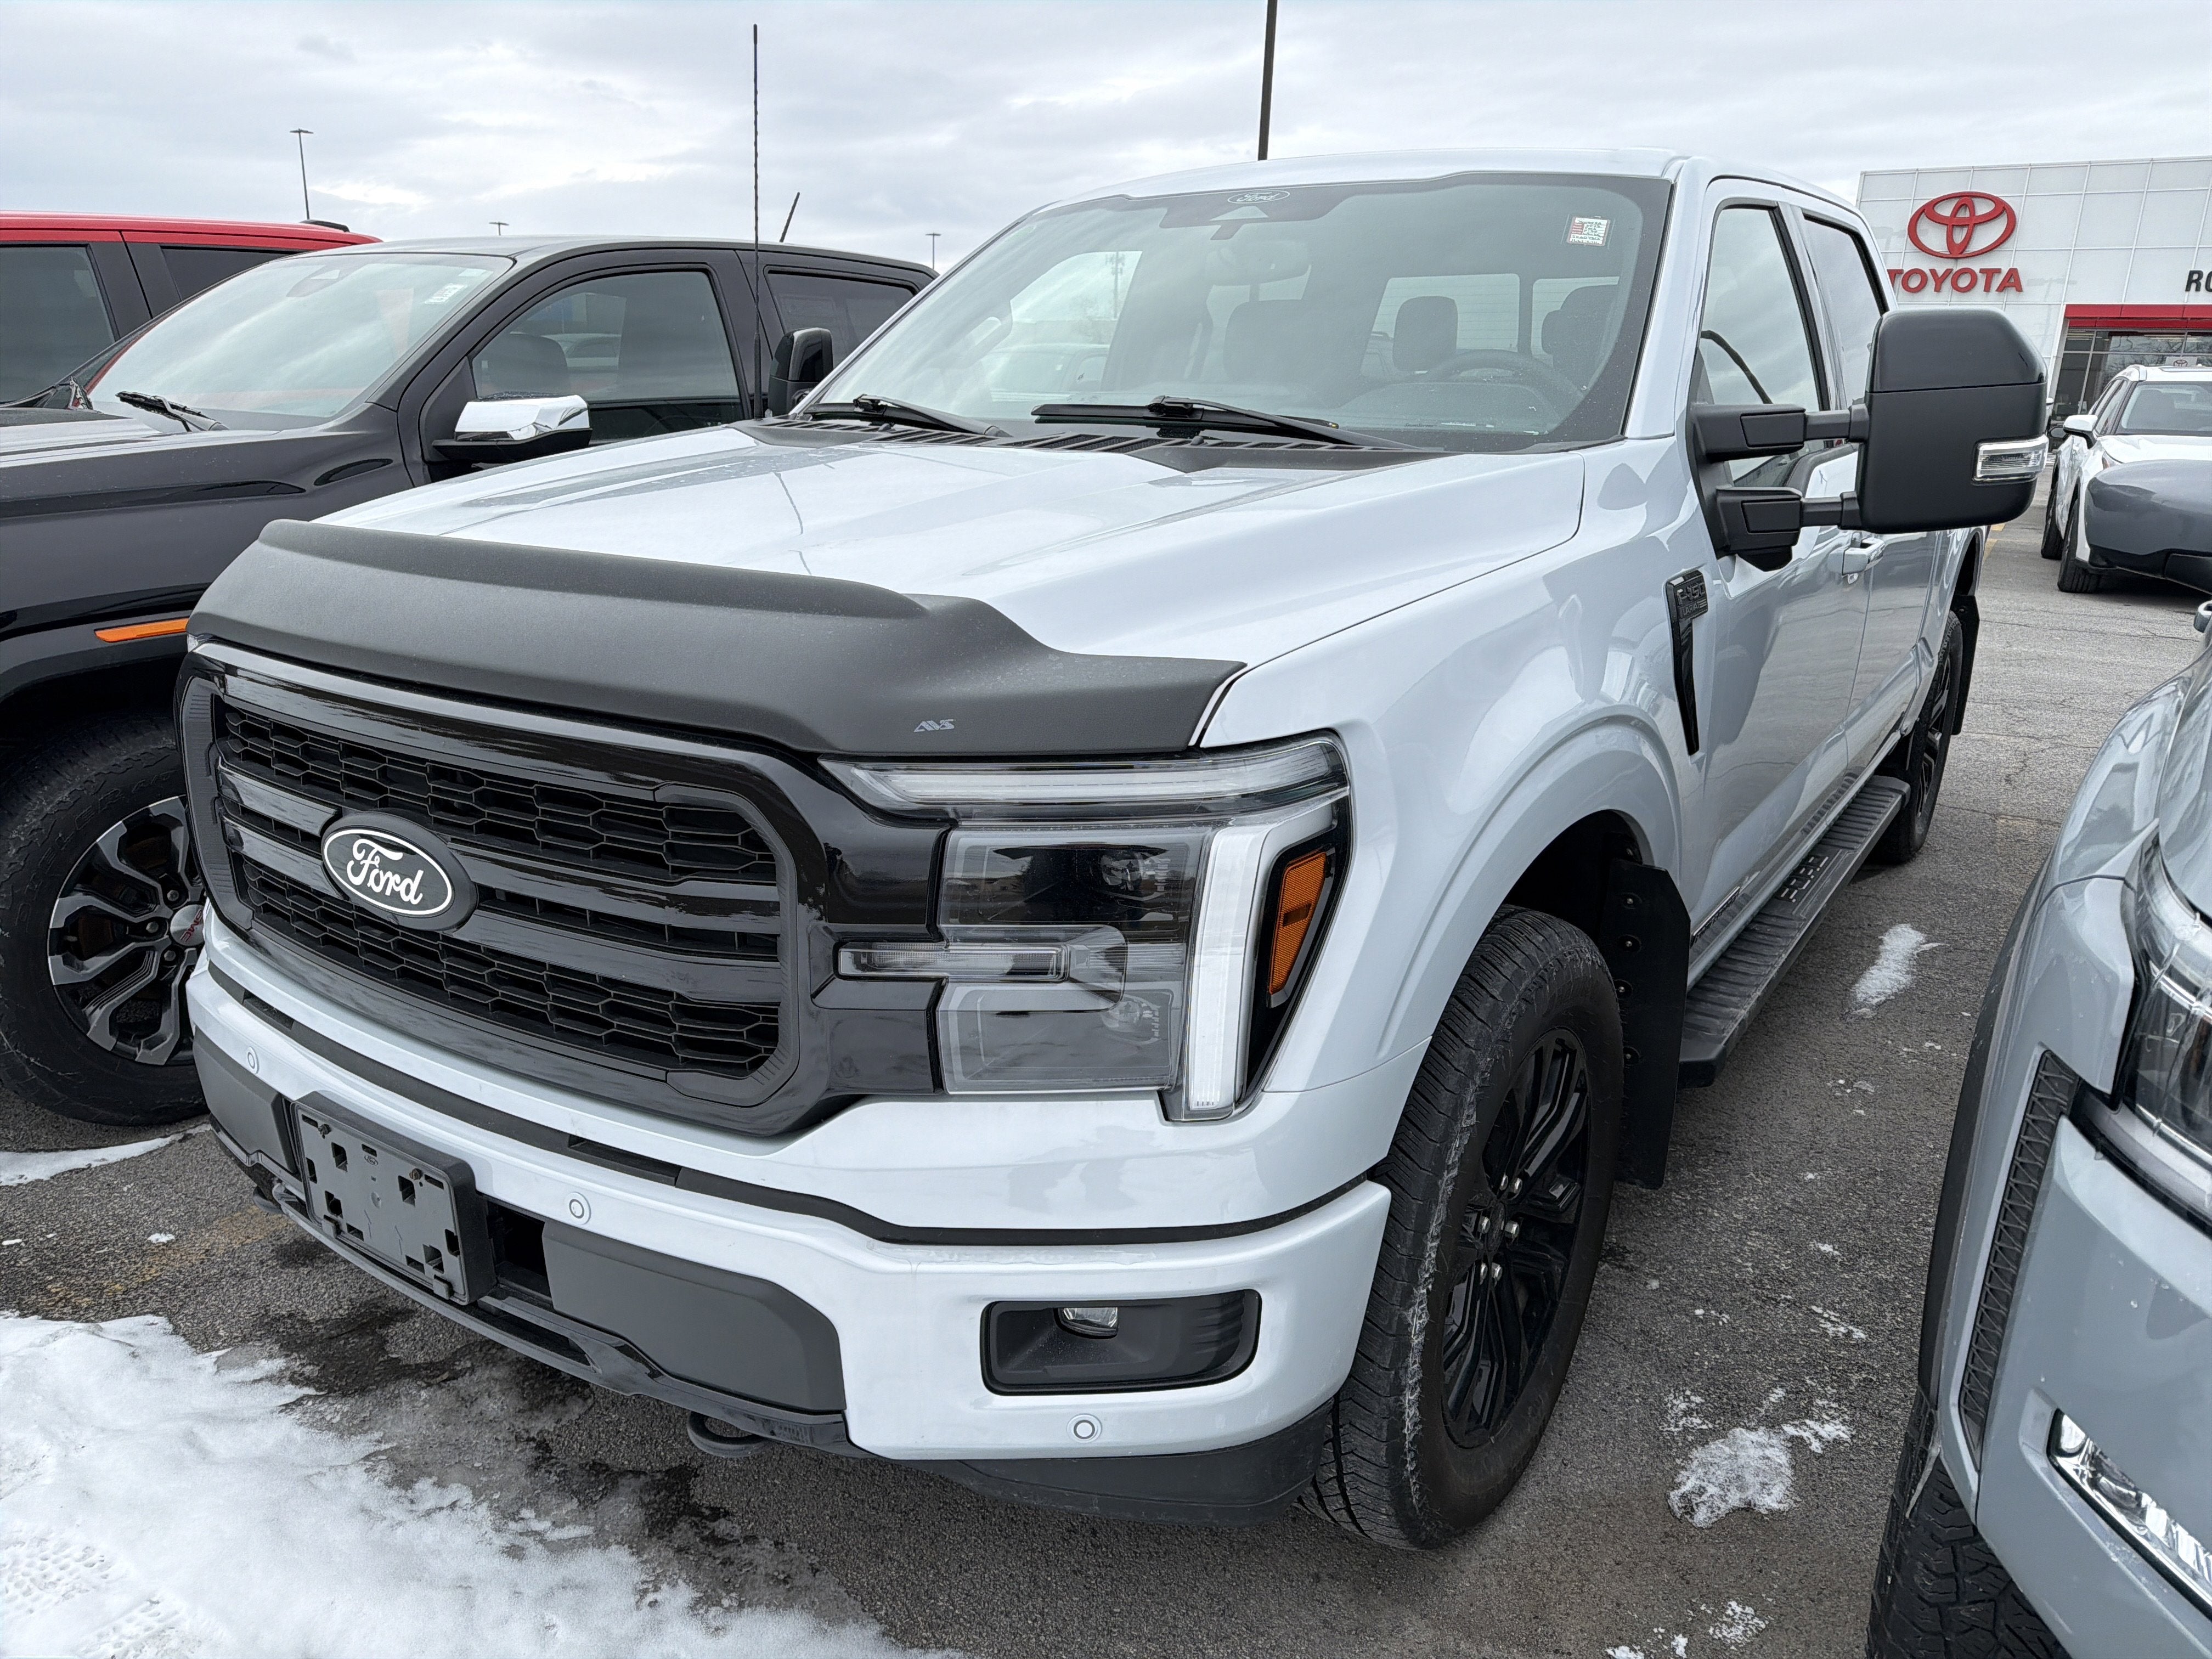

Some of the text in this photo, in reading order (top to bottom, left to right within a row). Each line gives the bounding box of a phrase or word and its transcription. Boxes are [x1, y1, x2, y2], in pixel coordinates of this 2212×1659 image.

[1237, 192, 1279, 202] Ford
[1887, 267, 2023, 293] TOYOTA
[913, 719, 955, 732] AVS
[347, 838, 424, 905] Ford
[180, 908, 202, 943] GMC
